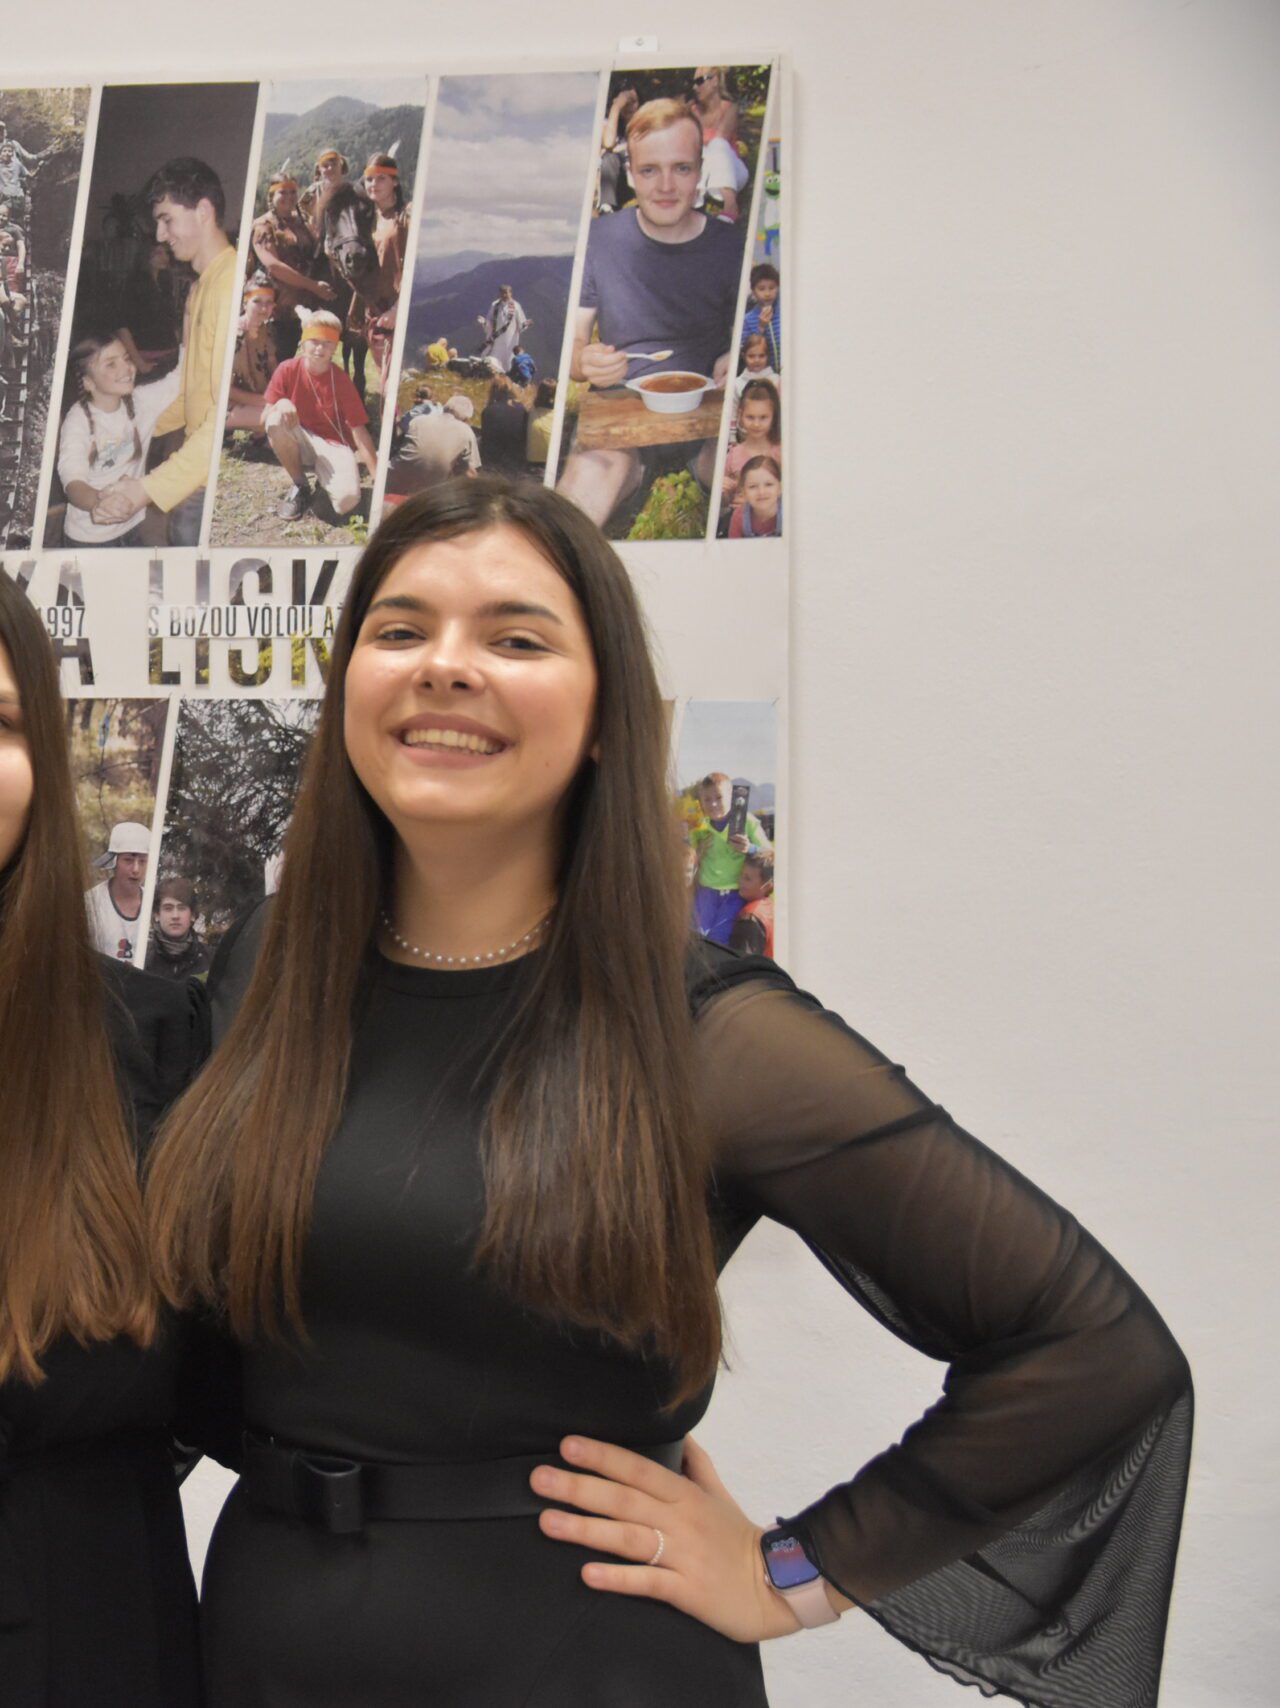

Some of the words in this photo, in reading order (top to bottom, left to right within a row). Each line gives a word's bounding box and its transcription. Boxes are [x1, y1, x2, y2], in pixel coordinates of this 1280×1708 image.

[148, 605, 160, 638] S
[170, 601, 237, 638] BOŽOU
[322, 602, 343, 638] A
